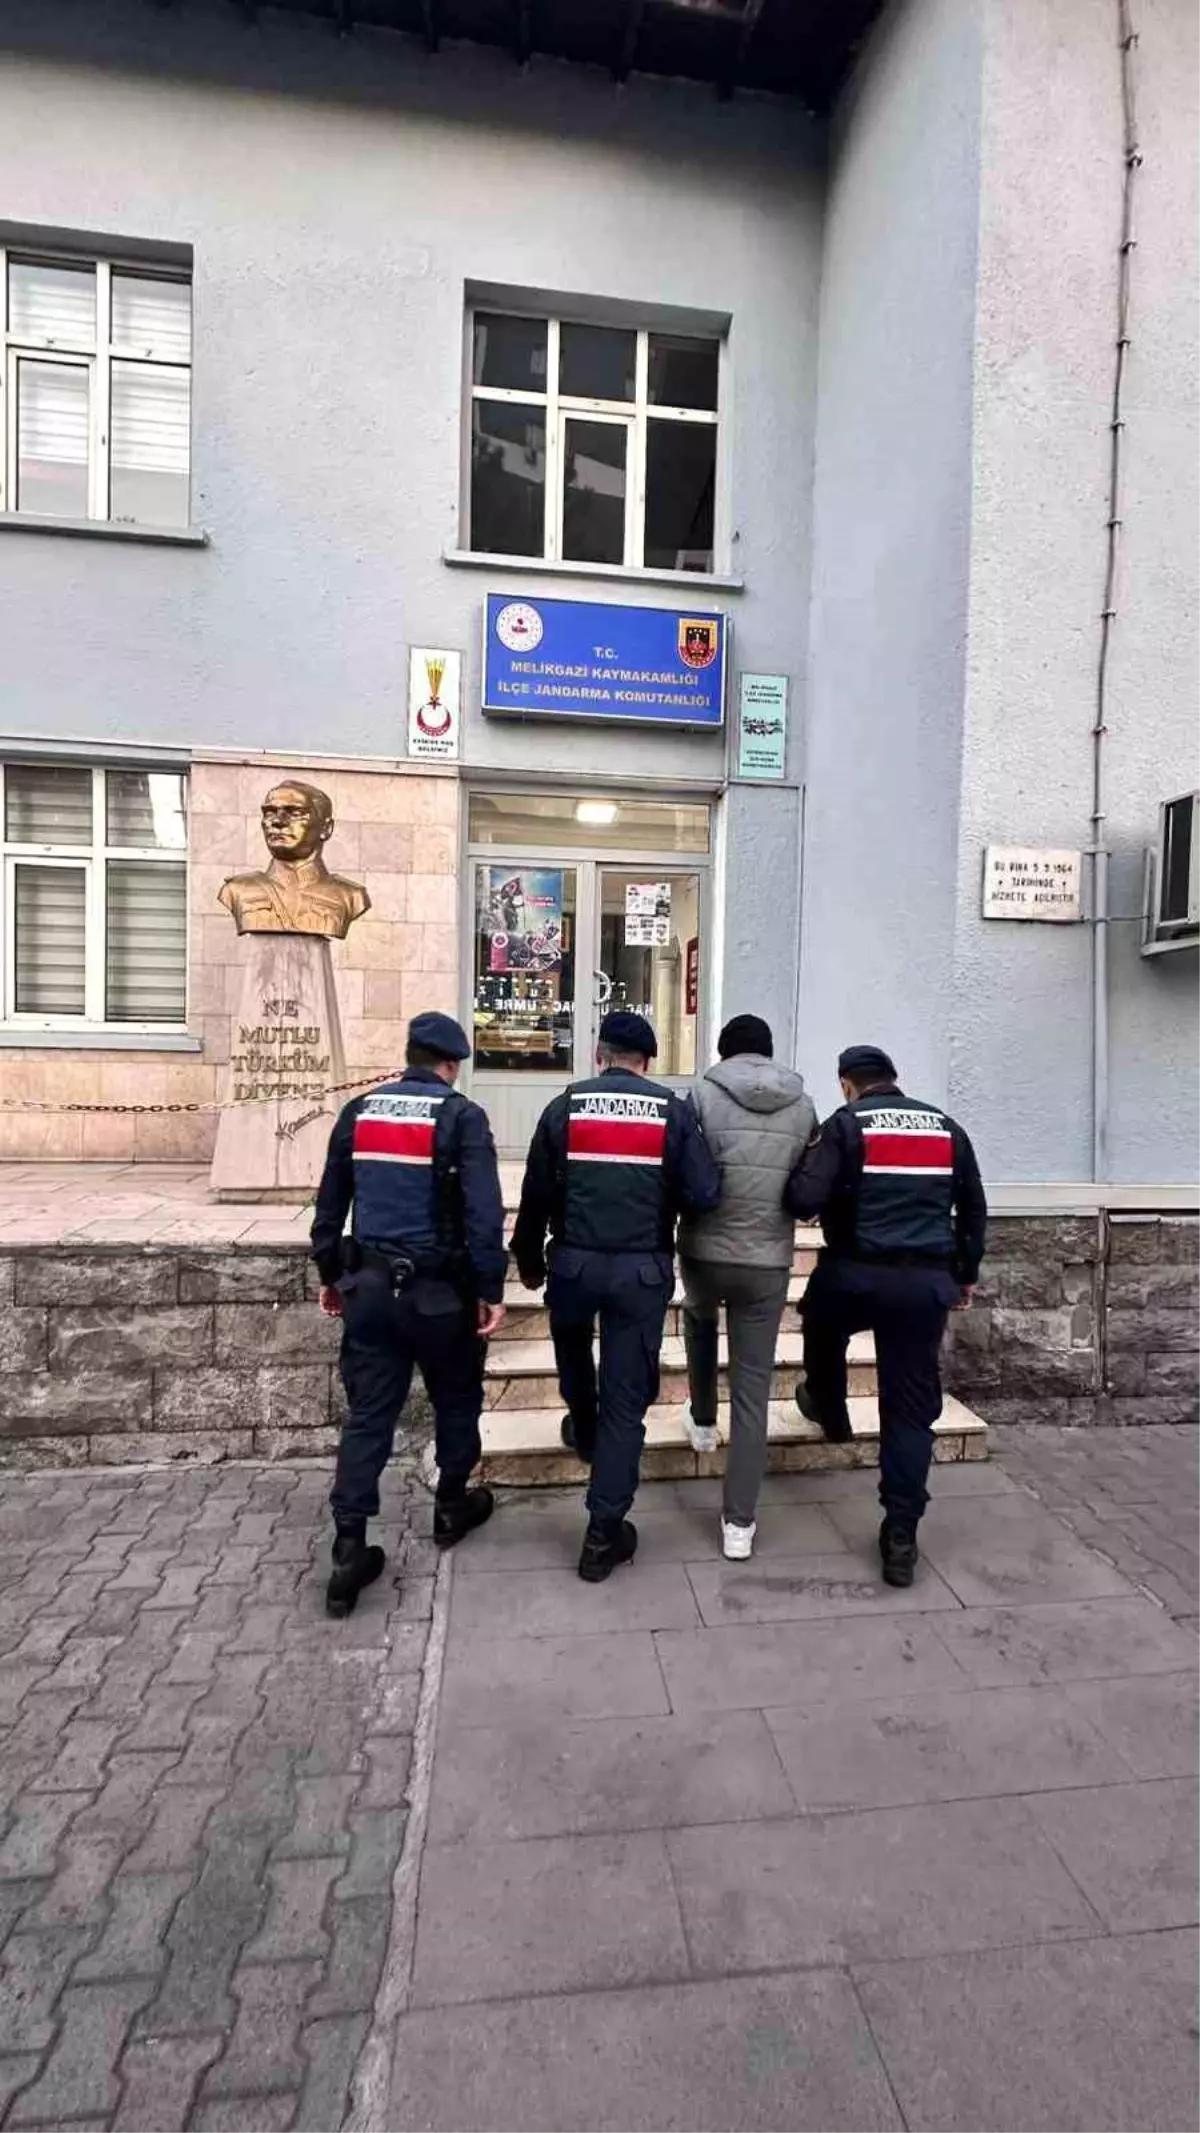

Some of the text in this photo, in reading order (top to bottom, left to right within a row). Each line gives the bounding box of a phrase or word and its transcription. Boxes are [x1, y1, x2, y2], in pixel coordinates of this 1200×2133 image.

[594, 647, 619, 660] T.C.
[511, 661, 699, 686] MELİKGAZİ KAYMAKAMLIĞI
[497, 680, 711, 707] İLÇE JANDARMA KOMUTANLIĞI
[261, 1000, 299, 1018] NE
[239, 1026, 320, 1044] MUTLU
[230, 1048, 330, 1073] TÜRKÜM
[579, 1098, 659, 1118] JANDARMA
[870, 1112, 943, 1131] JANDARMA
